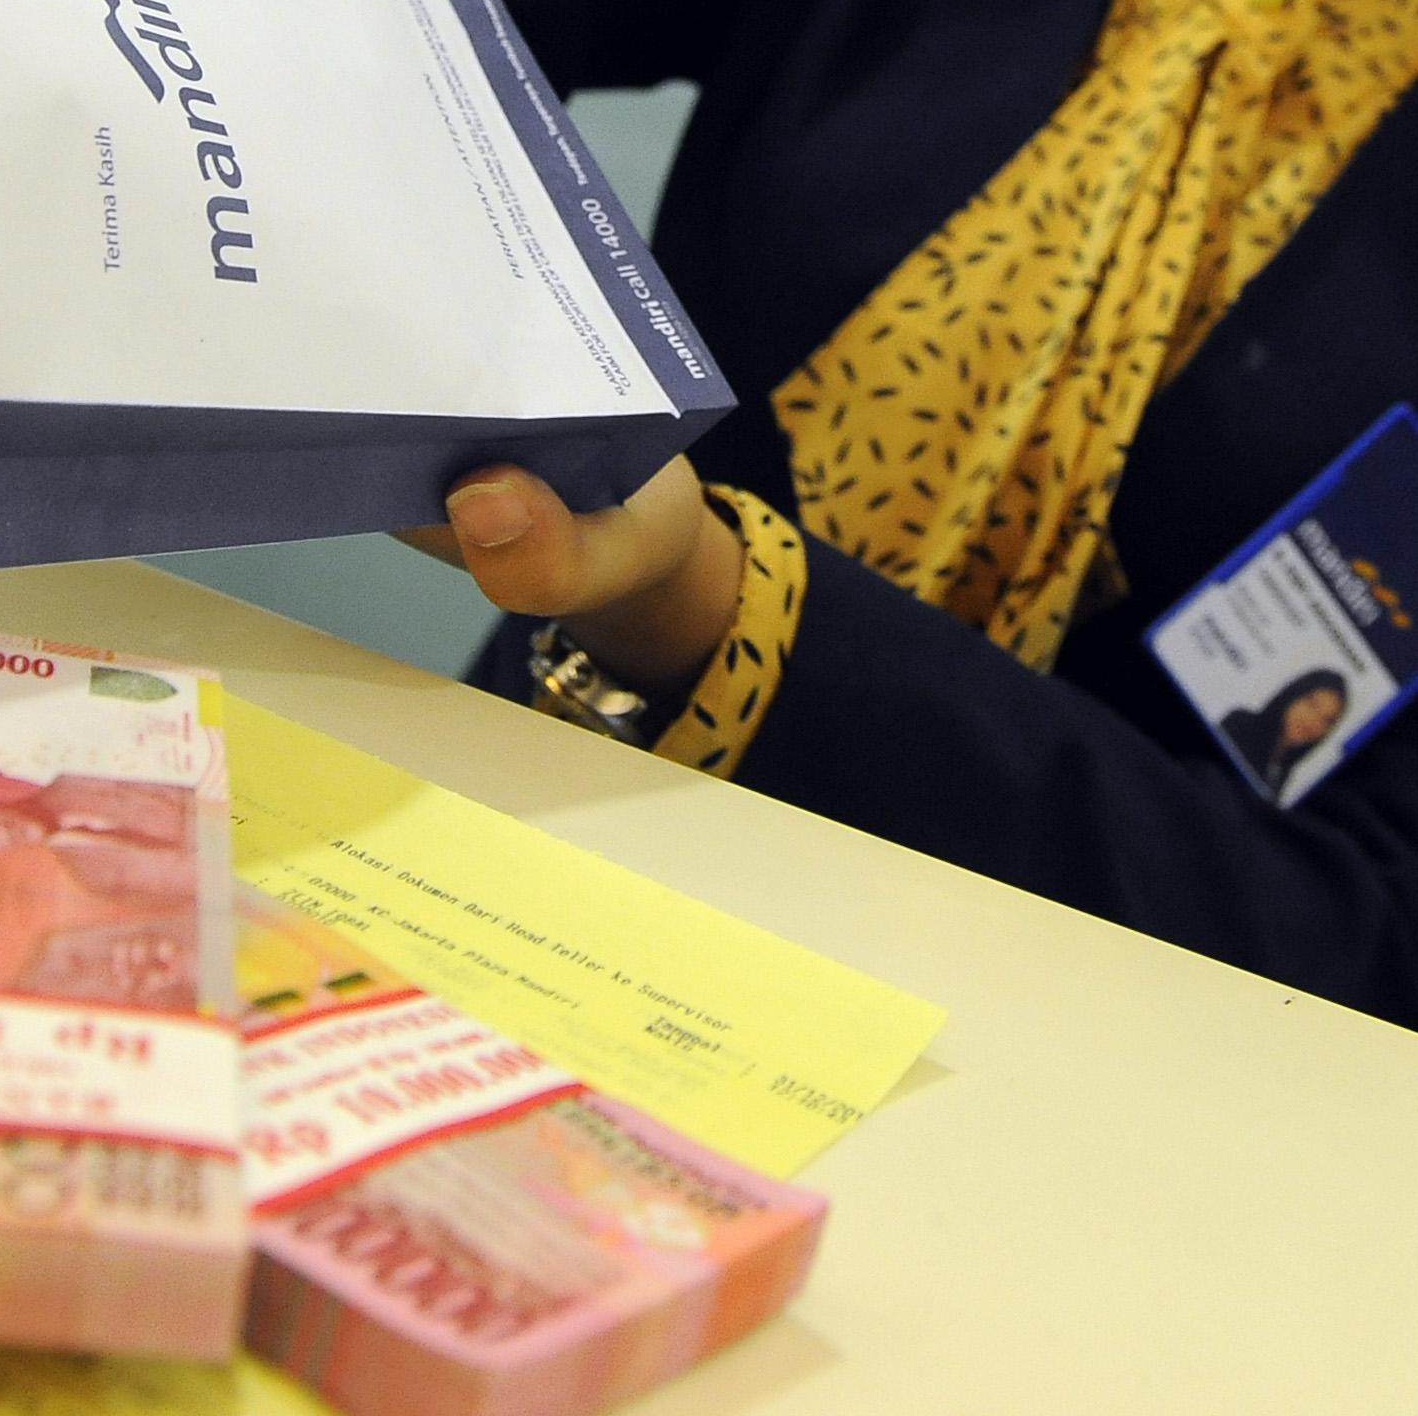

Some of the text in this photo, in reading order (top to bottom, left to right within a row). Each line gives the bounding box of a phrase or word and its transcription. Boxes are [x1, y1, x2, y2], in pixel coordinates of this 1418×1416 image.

[94, 126, 122, 274] Terima Kasih
[472, 181, 524, 279] PERHATIAN
[580, 196, 626, 259] 14000
[616, 262, 651, 300] call
[581, 338, 604, 363] ATAS
[590, 333, 610, 354] FOR
[640, 299, 704, 380] mandiri
[599, 365, 626, 396] KLAIM
[604, 356, 632, 388] CLAIM
[329, 839, 392, 873] Alokasi
[396, 870, 461, 905] Dokumen
[461, 901, 500, 925] Dari
[550, 941, 606, 976] Teller
[613, 968, 636, 986] ke
[637, 983, 733, 1033] Supervisor
[392, 917, 457, 952] Jakarta
